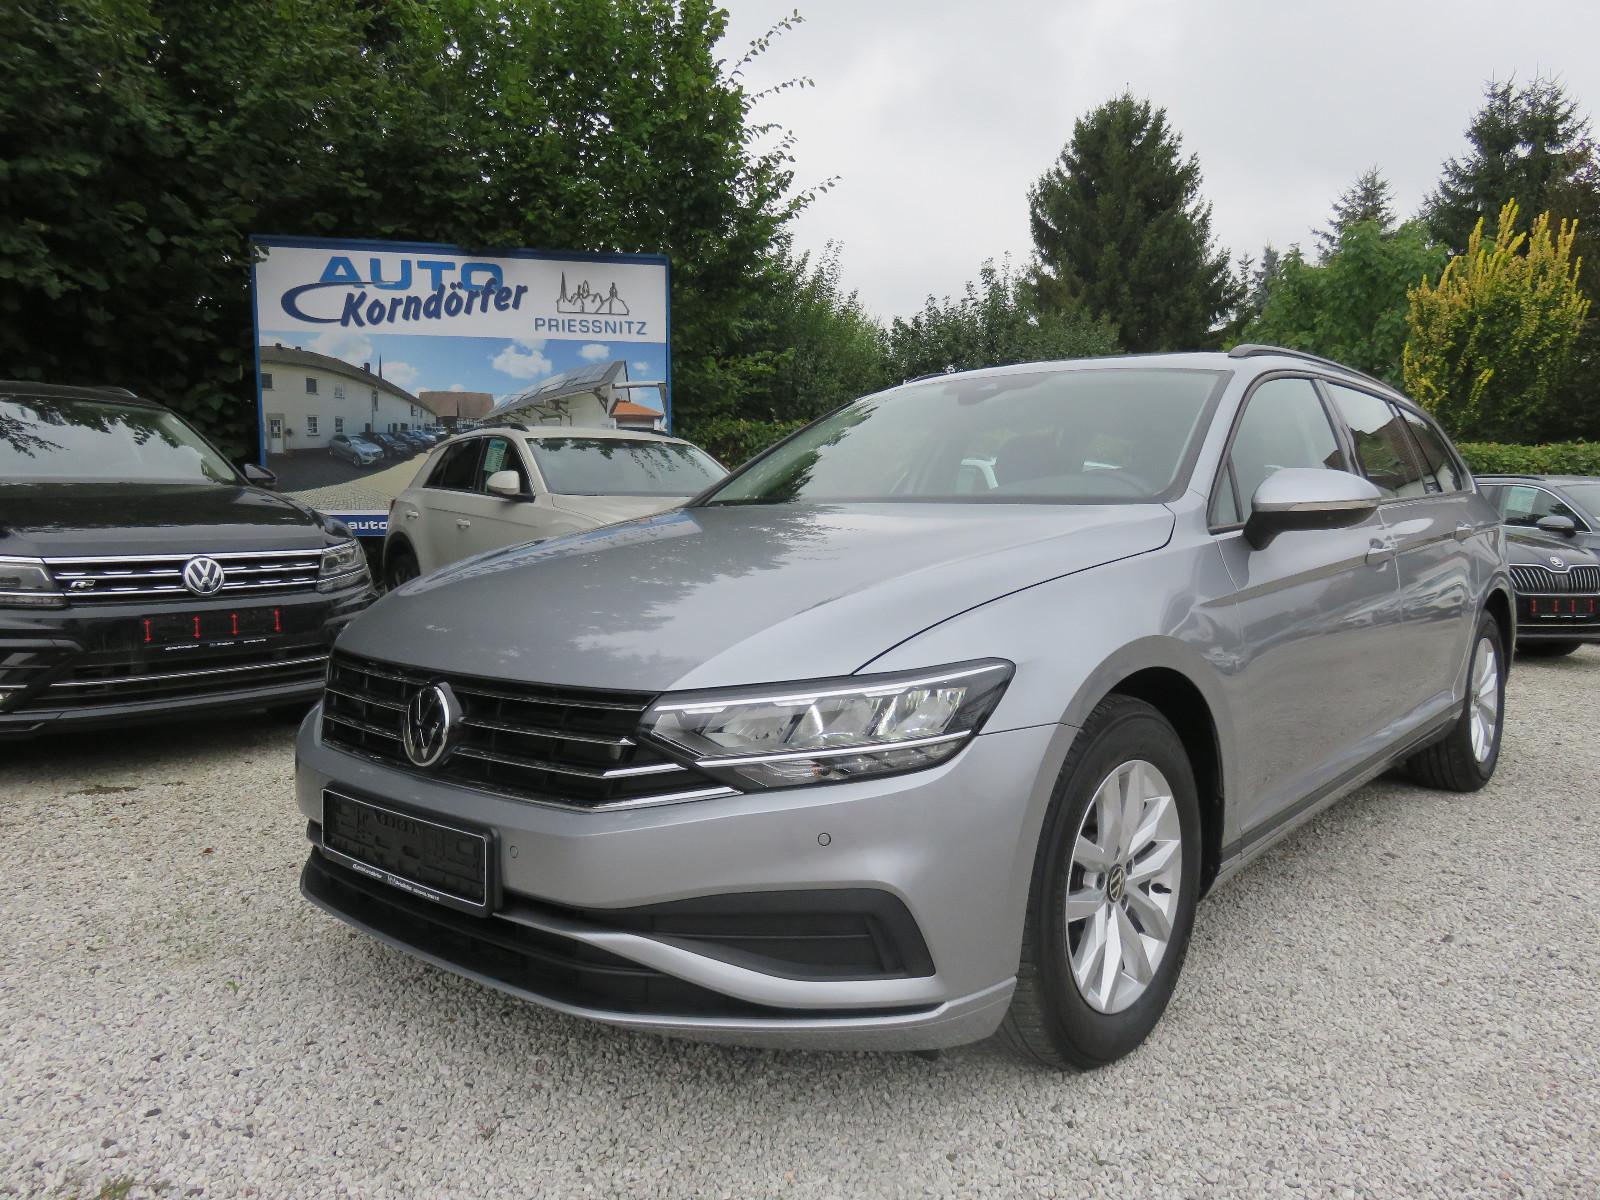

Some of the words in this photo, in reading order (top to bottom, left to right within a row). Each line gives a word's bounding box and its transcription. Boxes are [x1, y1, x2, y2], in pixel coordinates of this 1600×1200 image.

[319, 256, 504, 292] AUTO
[339, 277, 529, 328] Korndörfer
[534, 317, 648, 336] PRIESSNITZ
